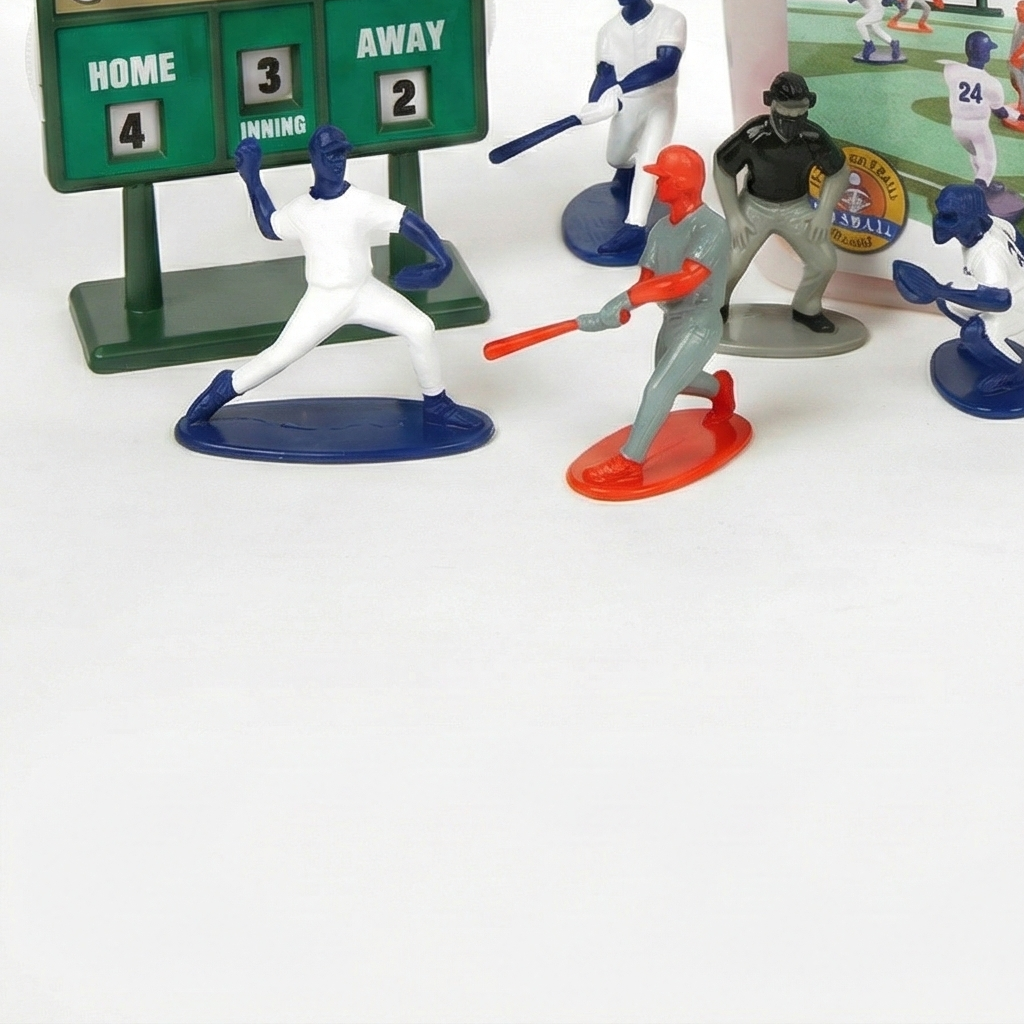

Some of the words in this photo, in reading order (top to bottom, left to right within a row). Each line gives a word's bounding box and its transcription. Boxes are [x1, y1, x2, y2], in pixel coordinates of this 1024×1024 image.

[356, 19, 446, 59] AWAY
[88, 51, 177, 92] HOME
[257, 56, 282, 94] 3
[391, 79, 417, 117] 2
[958, 80, 984, 104] 24
[119, 111, 146, 149] 4
[240, 115, 307, 140] INNING
